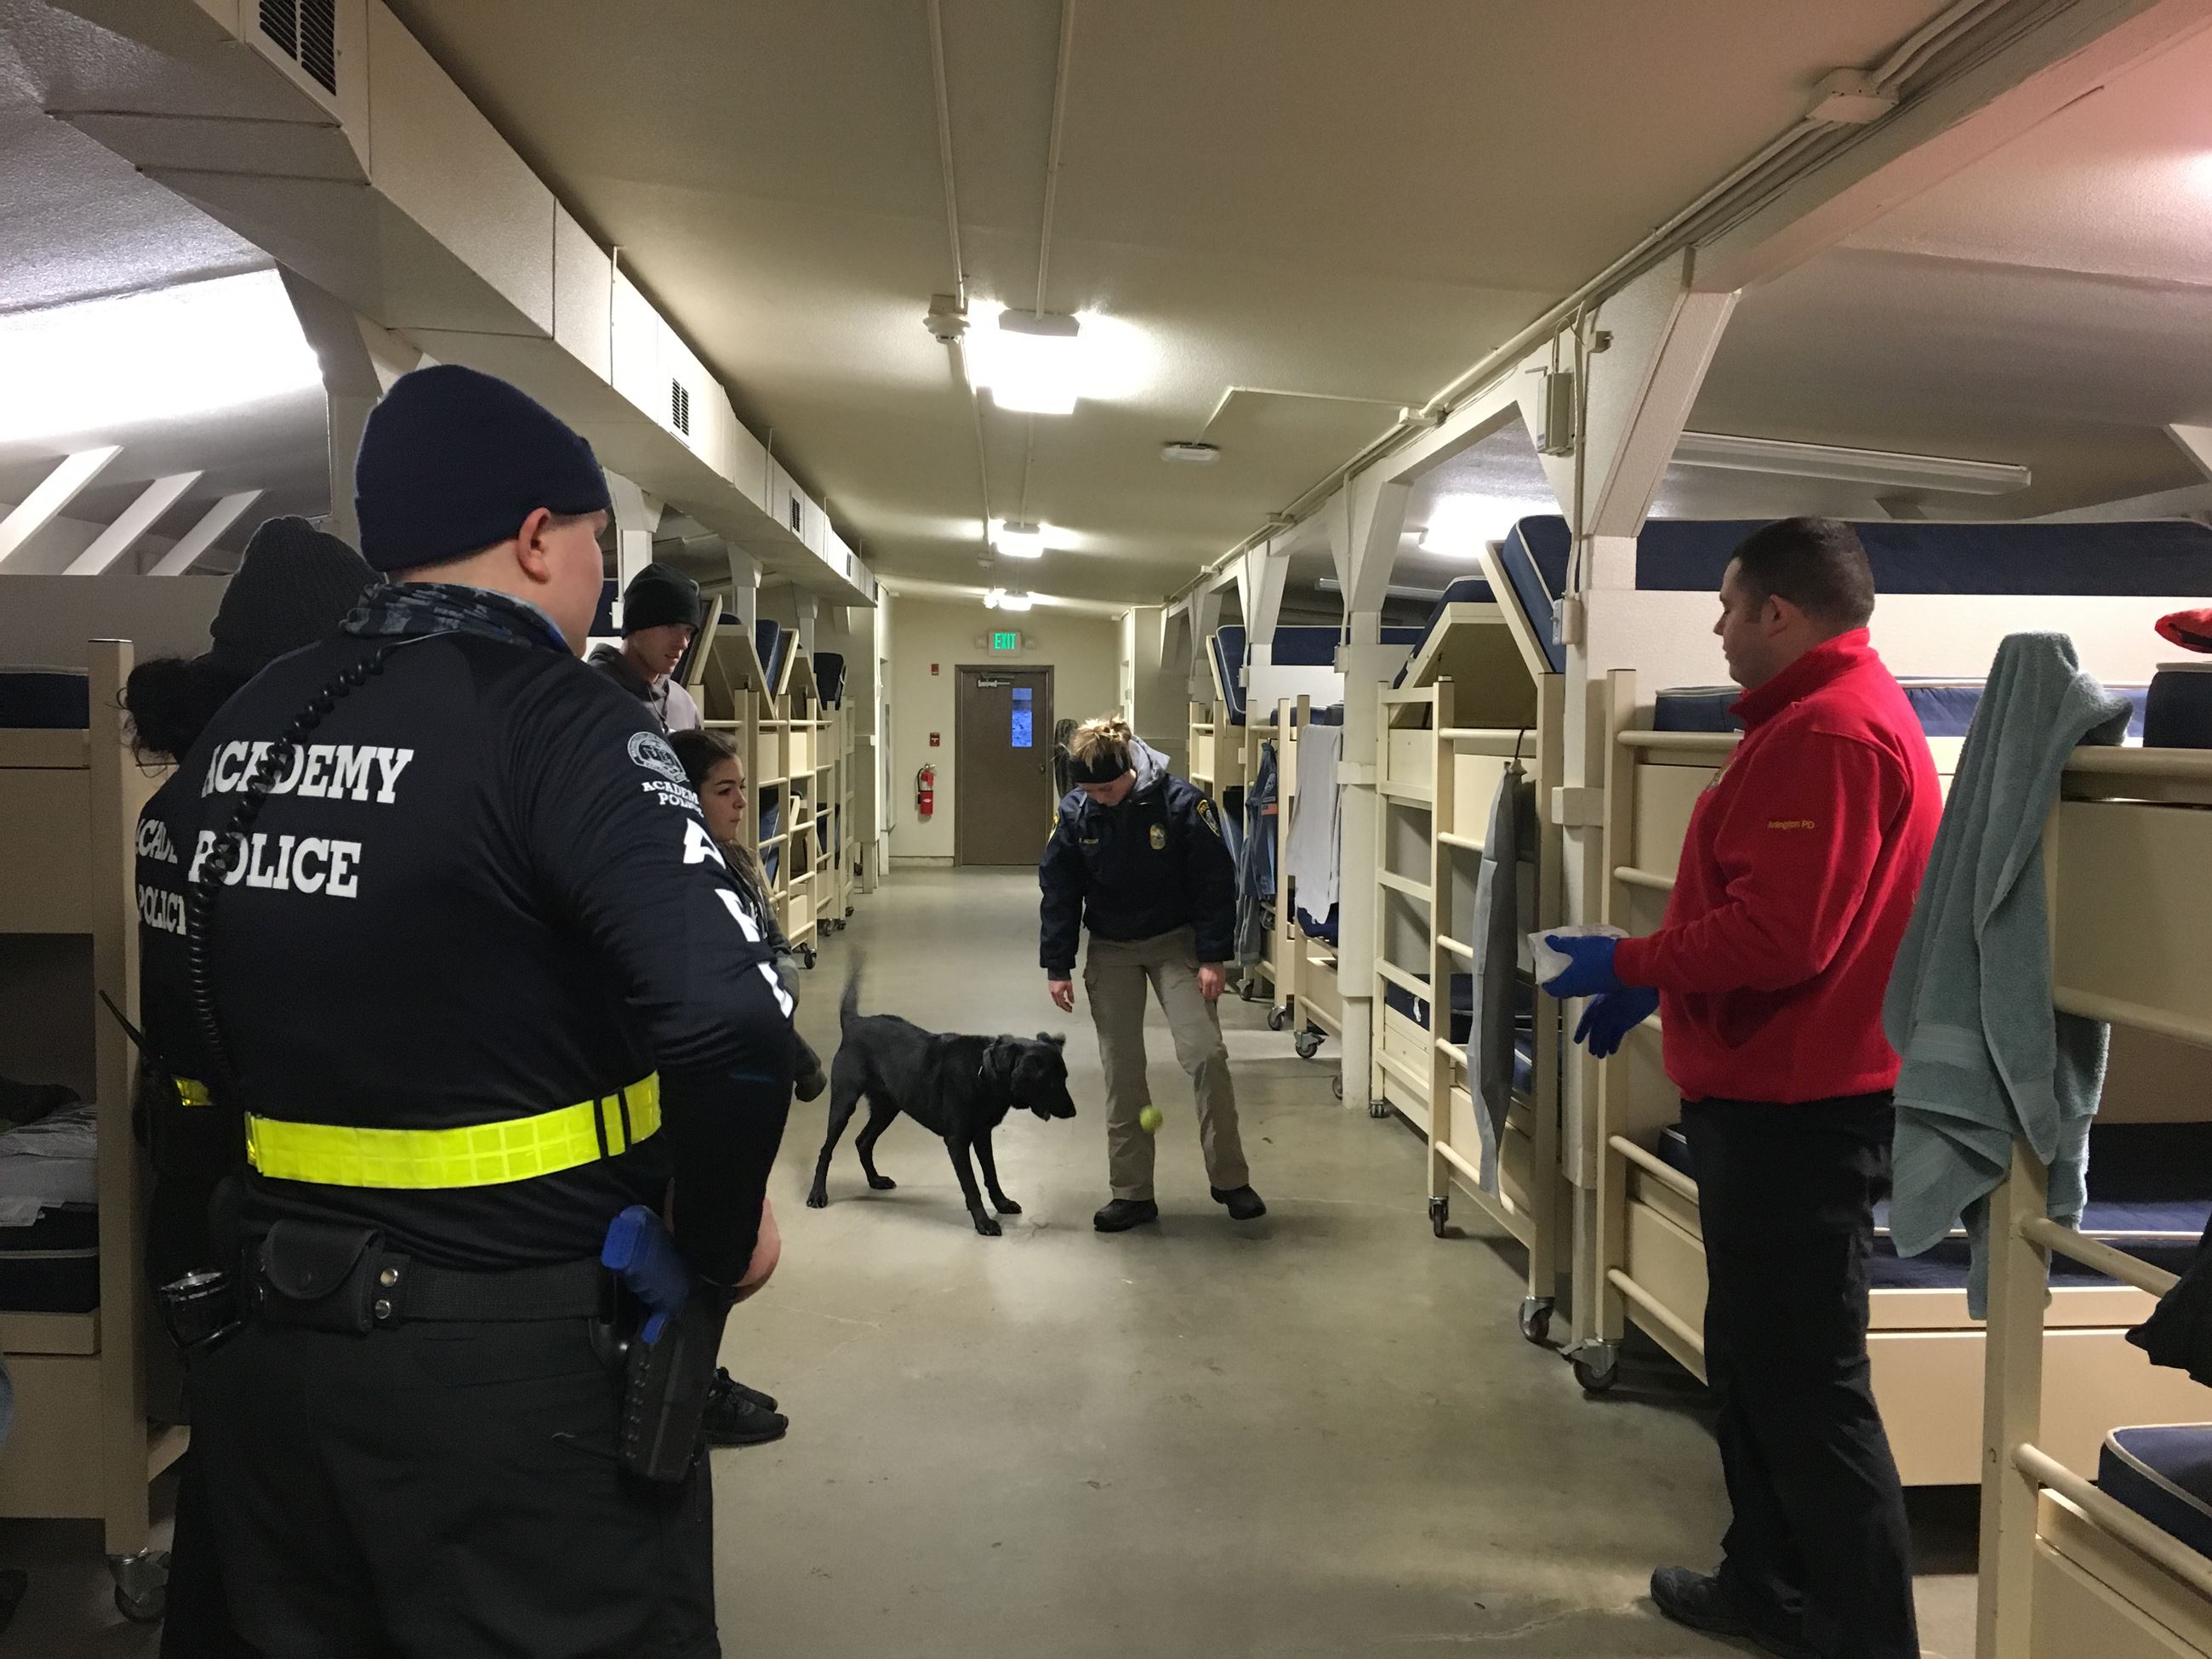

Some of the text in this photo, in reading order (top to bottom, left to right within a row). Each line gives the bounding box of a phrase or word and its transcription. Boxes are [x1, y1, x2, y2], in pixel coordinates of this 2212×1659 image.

[995, 633, 1016, 649] EXIT
[641, 780, 699, 805] ACADEM
[1802, 820, 1816, 830] PD
[187, 830, 362, 898] POLICE
